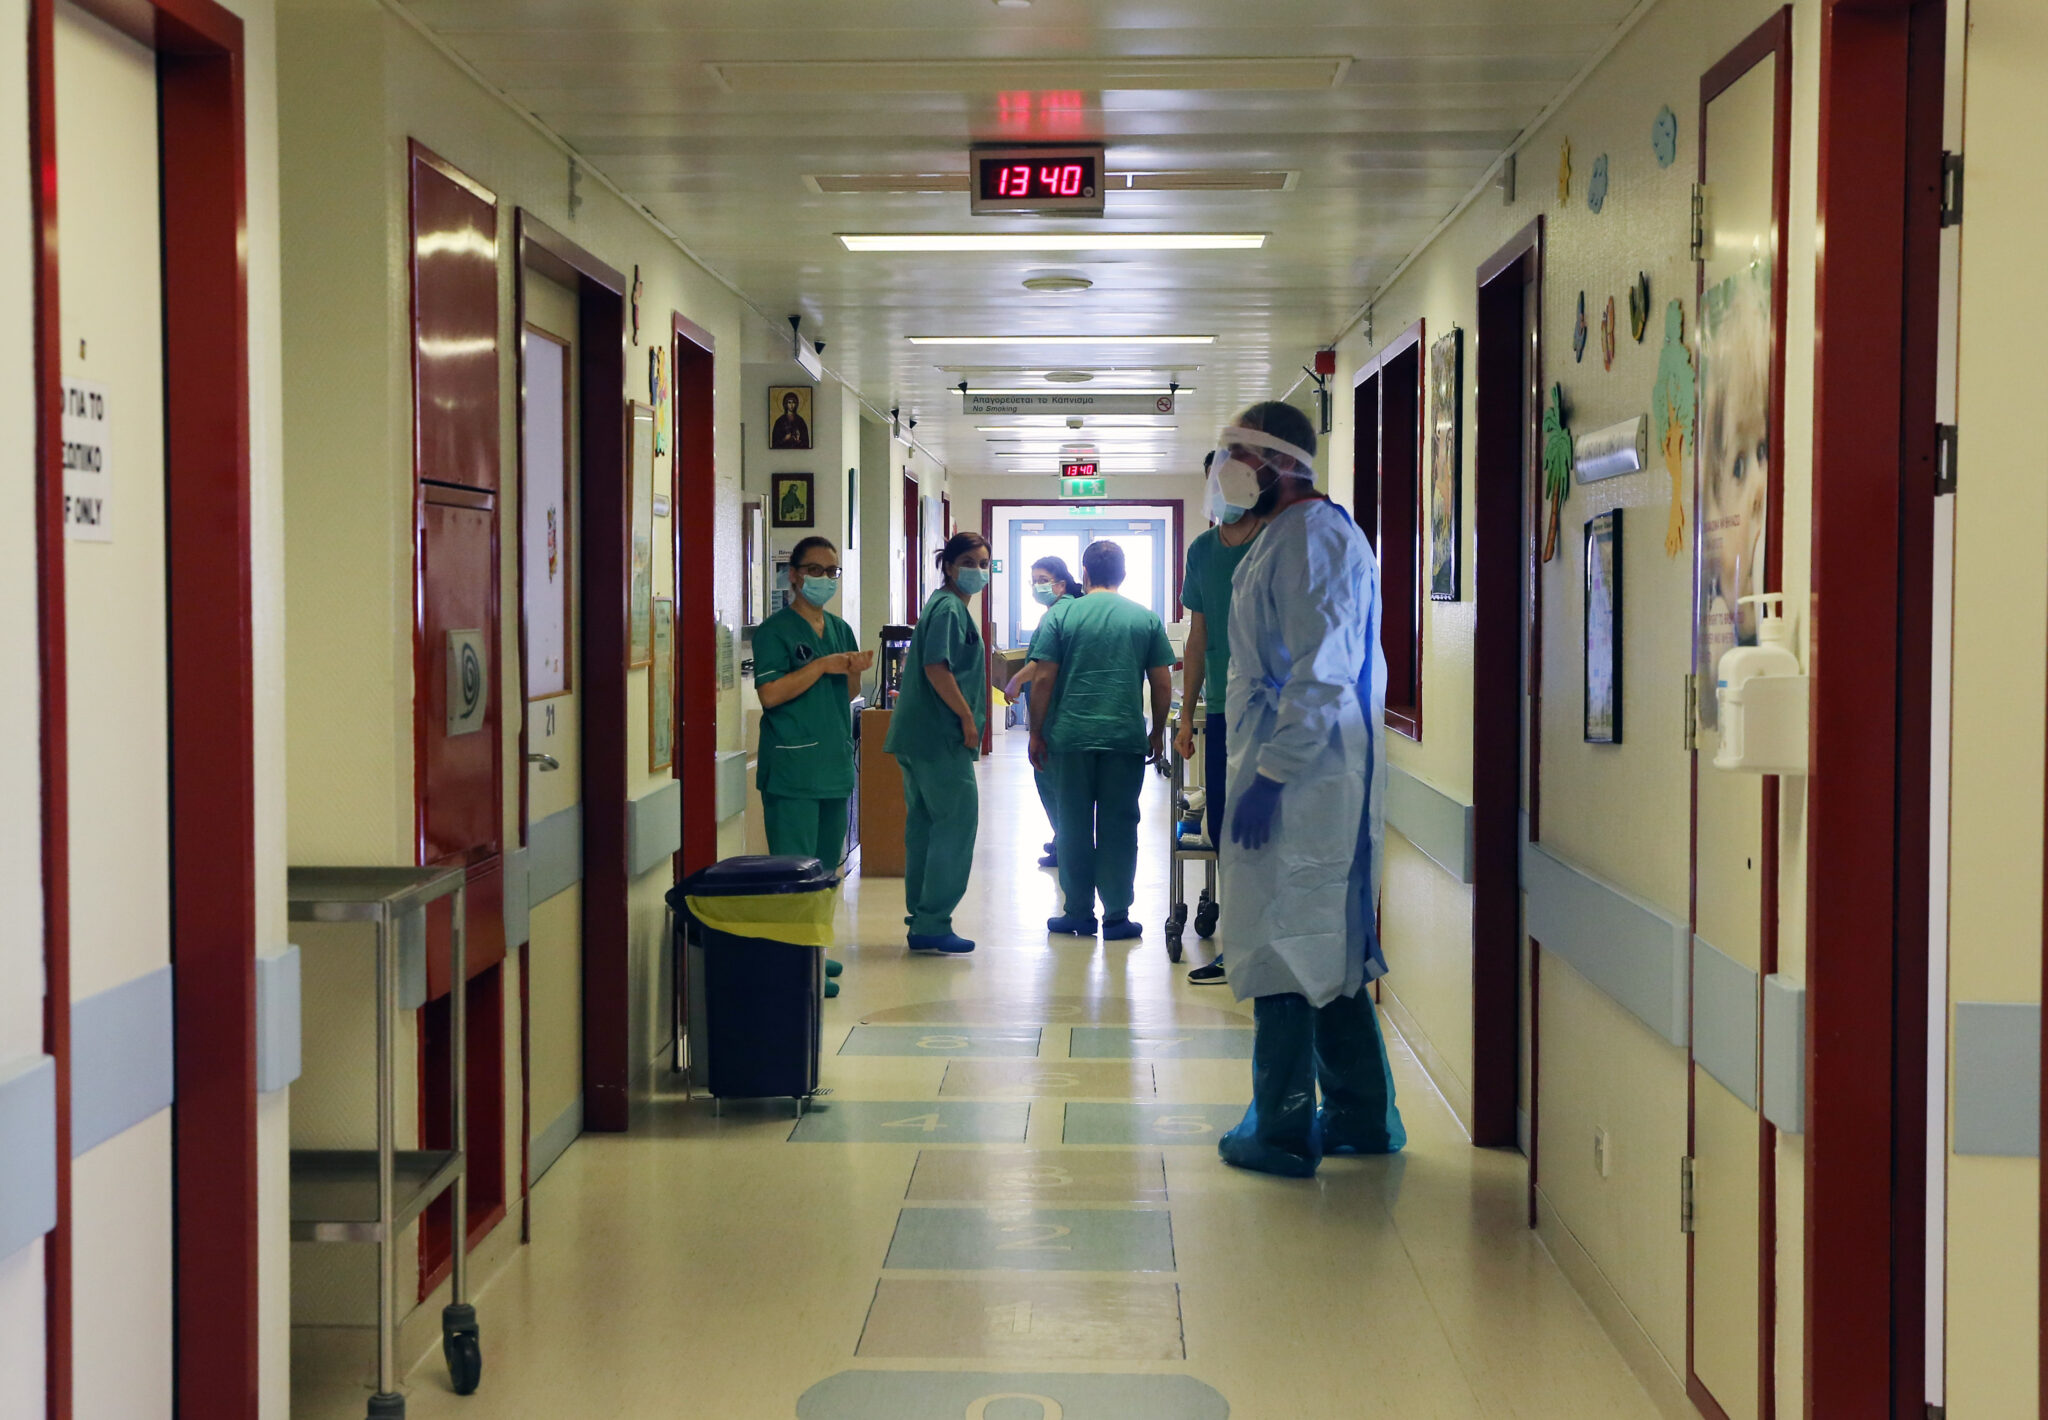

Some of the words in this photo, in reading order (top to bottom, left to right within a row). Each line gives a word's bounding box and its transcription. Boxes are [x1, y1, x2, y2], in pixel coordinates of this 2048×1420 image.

[998, 165, 1031, 196] 13
[1039, 165, 1082, 196] 40
[985, 405, 1018, 413] Smoking
[880, 1112, 948, 1132] 4
[1151, 1114, 1213, 1135] 5
[995, 1223, 1073, 1250] 2
[983, 1300, 1034, 1334] 1
